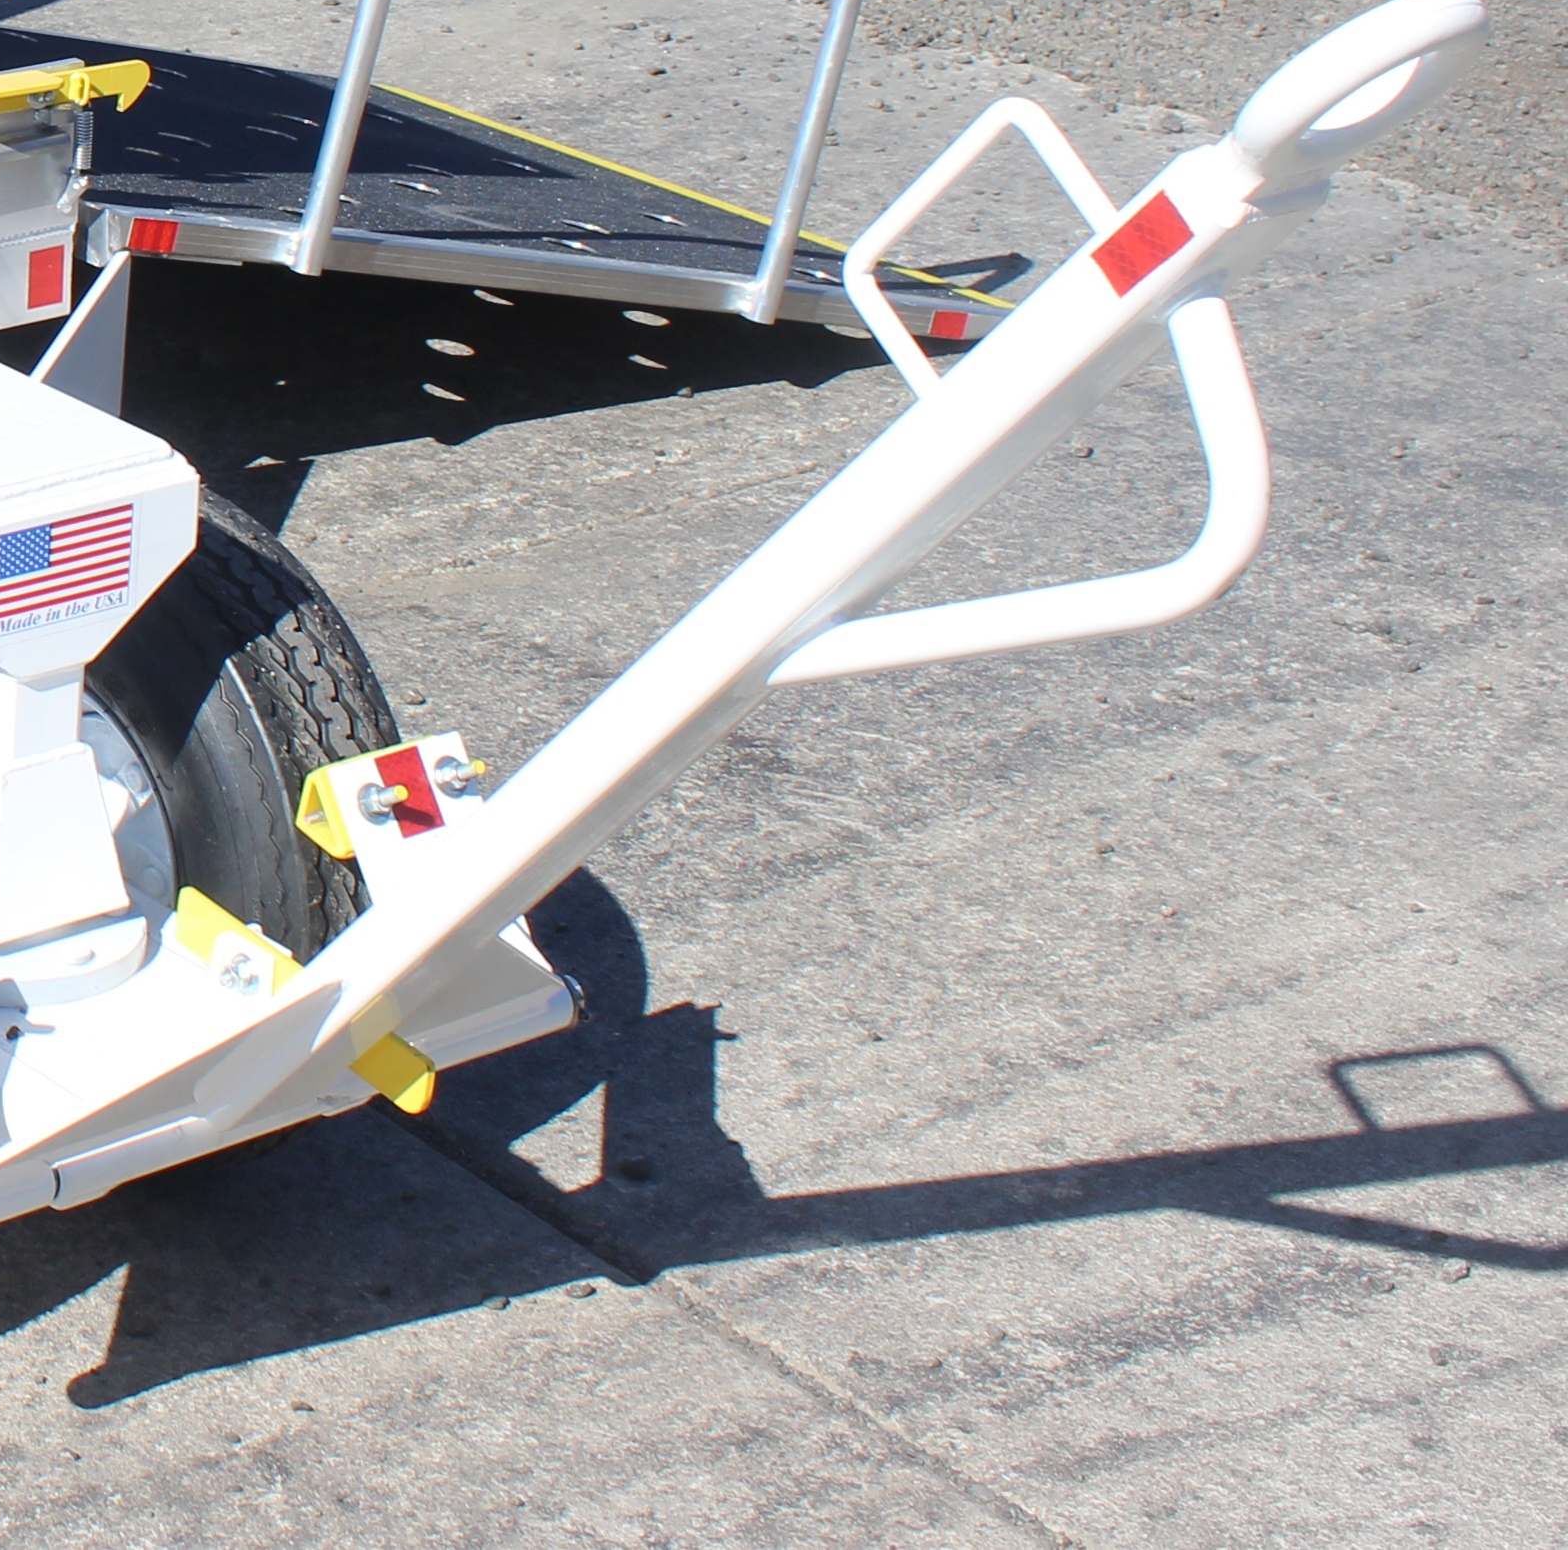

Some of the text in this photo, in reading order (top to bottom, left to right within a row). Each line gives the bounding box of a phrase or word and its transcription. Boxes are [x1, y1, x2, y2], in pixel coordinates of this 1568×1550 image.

[45, 608, 61, 622] in
[64, 599, 90, 618] the
[94, 589, 124, 610] USA
